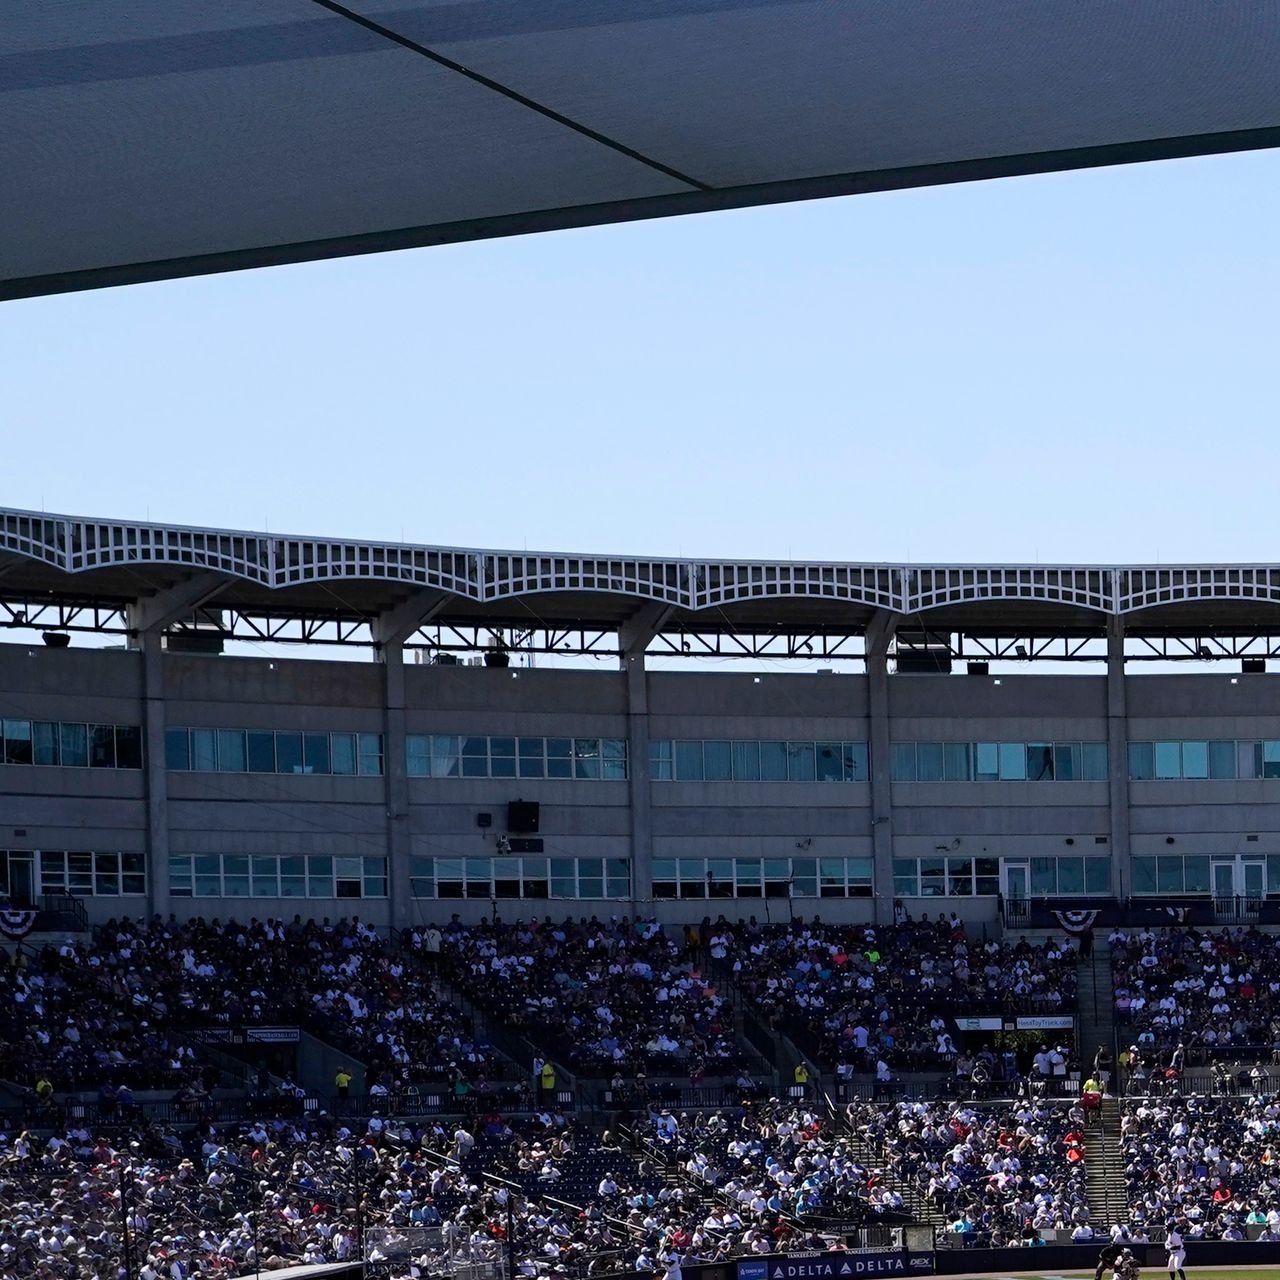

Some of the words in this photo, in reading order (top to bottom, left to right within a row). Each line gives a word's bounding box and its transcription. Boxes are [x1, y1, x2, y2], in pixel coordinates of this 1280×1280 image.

[856, 1259, 904, 1272] DELTA
[910, 1258, 930, 1266] DEX
[788, 1265, 832, 1276] DELTA
